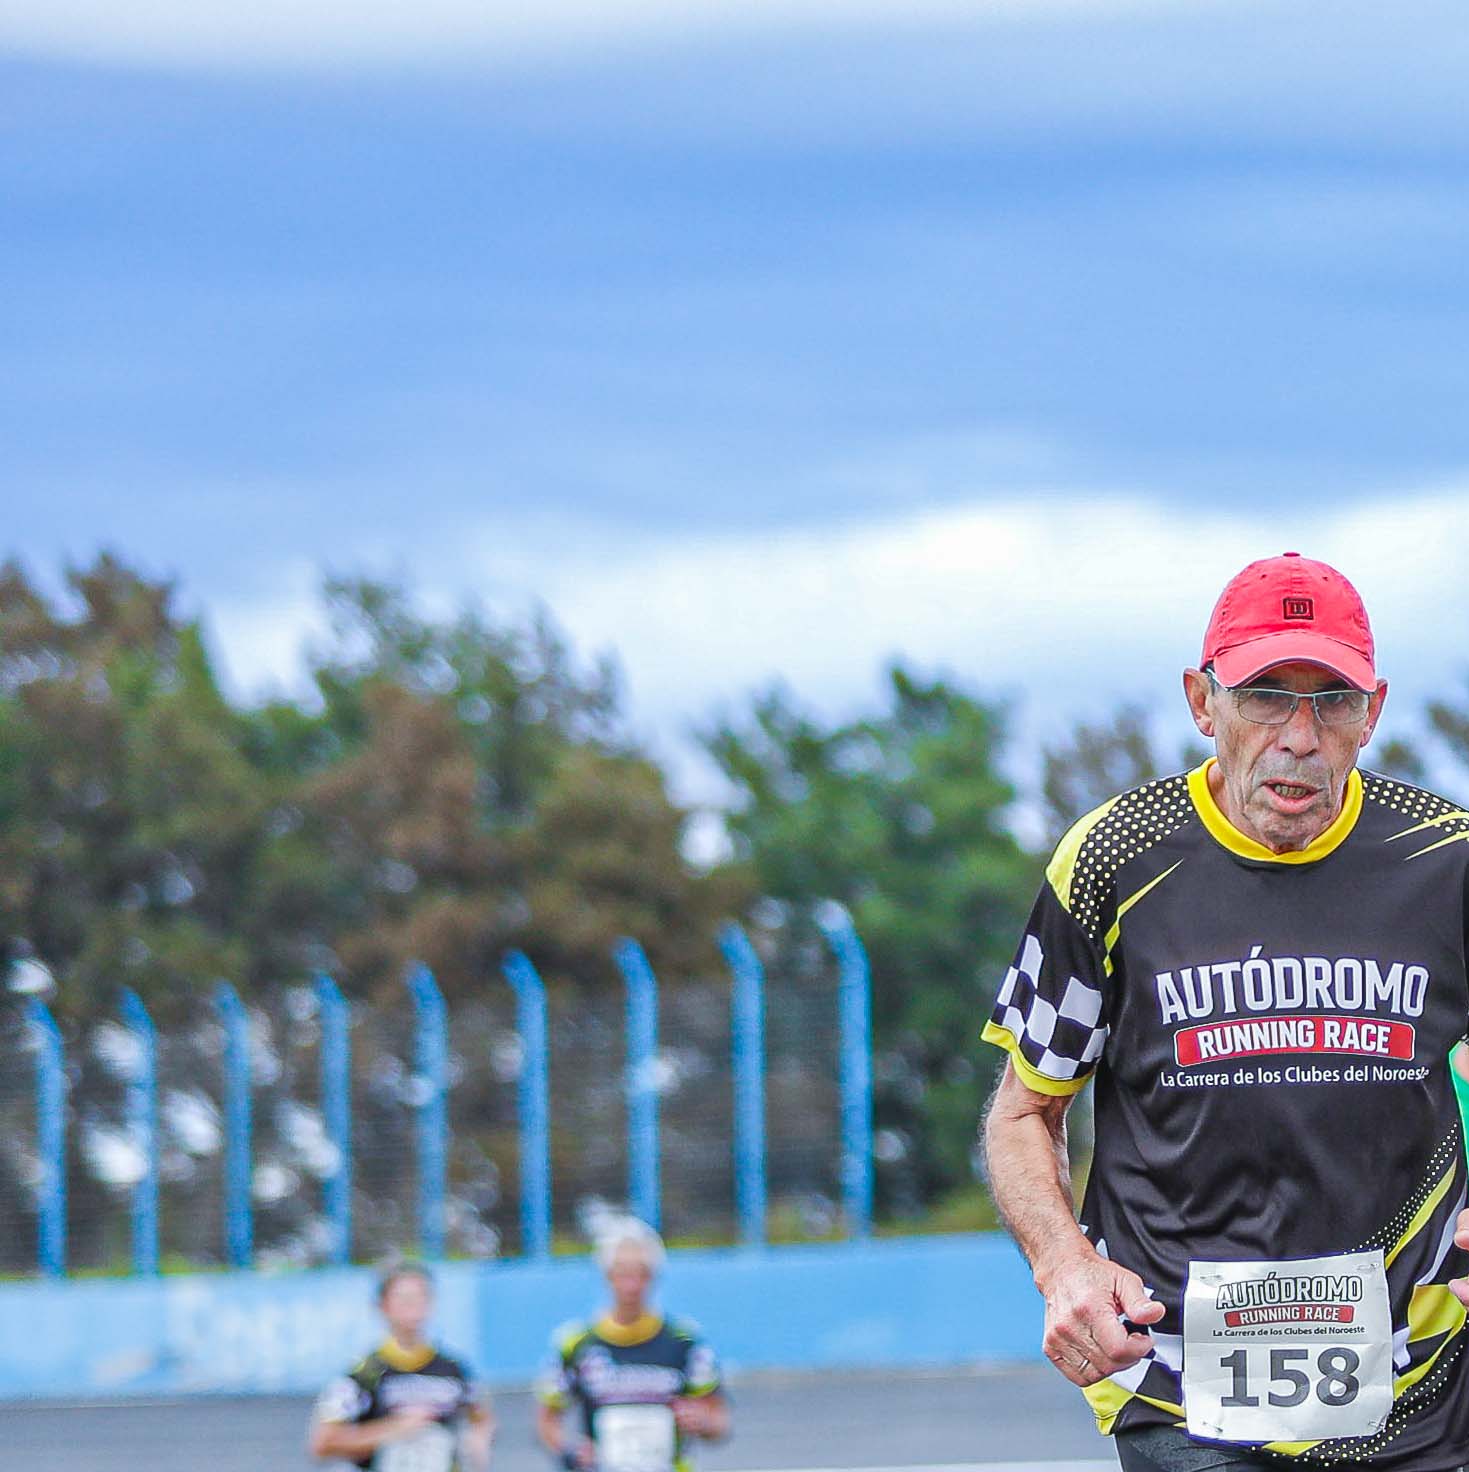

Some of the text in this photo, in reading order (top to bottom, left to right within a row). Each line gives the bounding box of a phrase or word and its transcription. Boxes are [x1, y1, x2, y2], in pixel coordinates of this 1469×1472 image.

[1155, 945, 1429, 1025] AUTÓDROMO
[1197, 1019, 1390, 1058] RUNNING RACE
[1160, 1071, 1175, 1087] La
[1177, 1071, 1229, 1087] Carrera
[1233, 1068, 1254, 1084] de
[1258, 1067, 1280, 1084] los
[1285, 1065, 1340, 1082] Clubes
[1344, 1065, 1369, 1082] del
[1216, 1272, 1363, 1309] AUTÓDROMO
[1213, 1329, 1223, 1337] La
[1224, 1329, 1256, 1337] Carrera
[1270, 1328, 1283, 1336] los
[1284, 1327, 1312, 1335] Clubes
[1313, 1327, 1327, 1335] del
[1328, 1326, 1365, 1334] Noroeste
[1239, 1306, 1340, 1325] RUNNING RACE
[1220, 1347, 1360, 1407] 158
